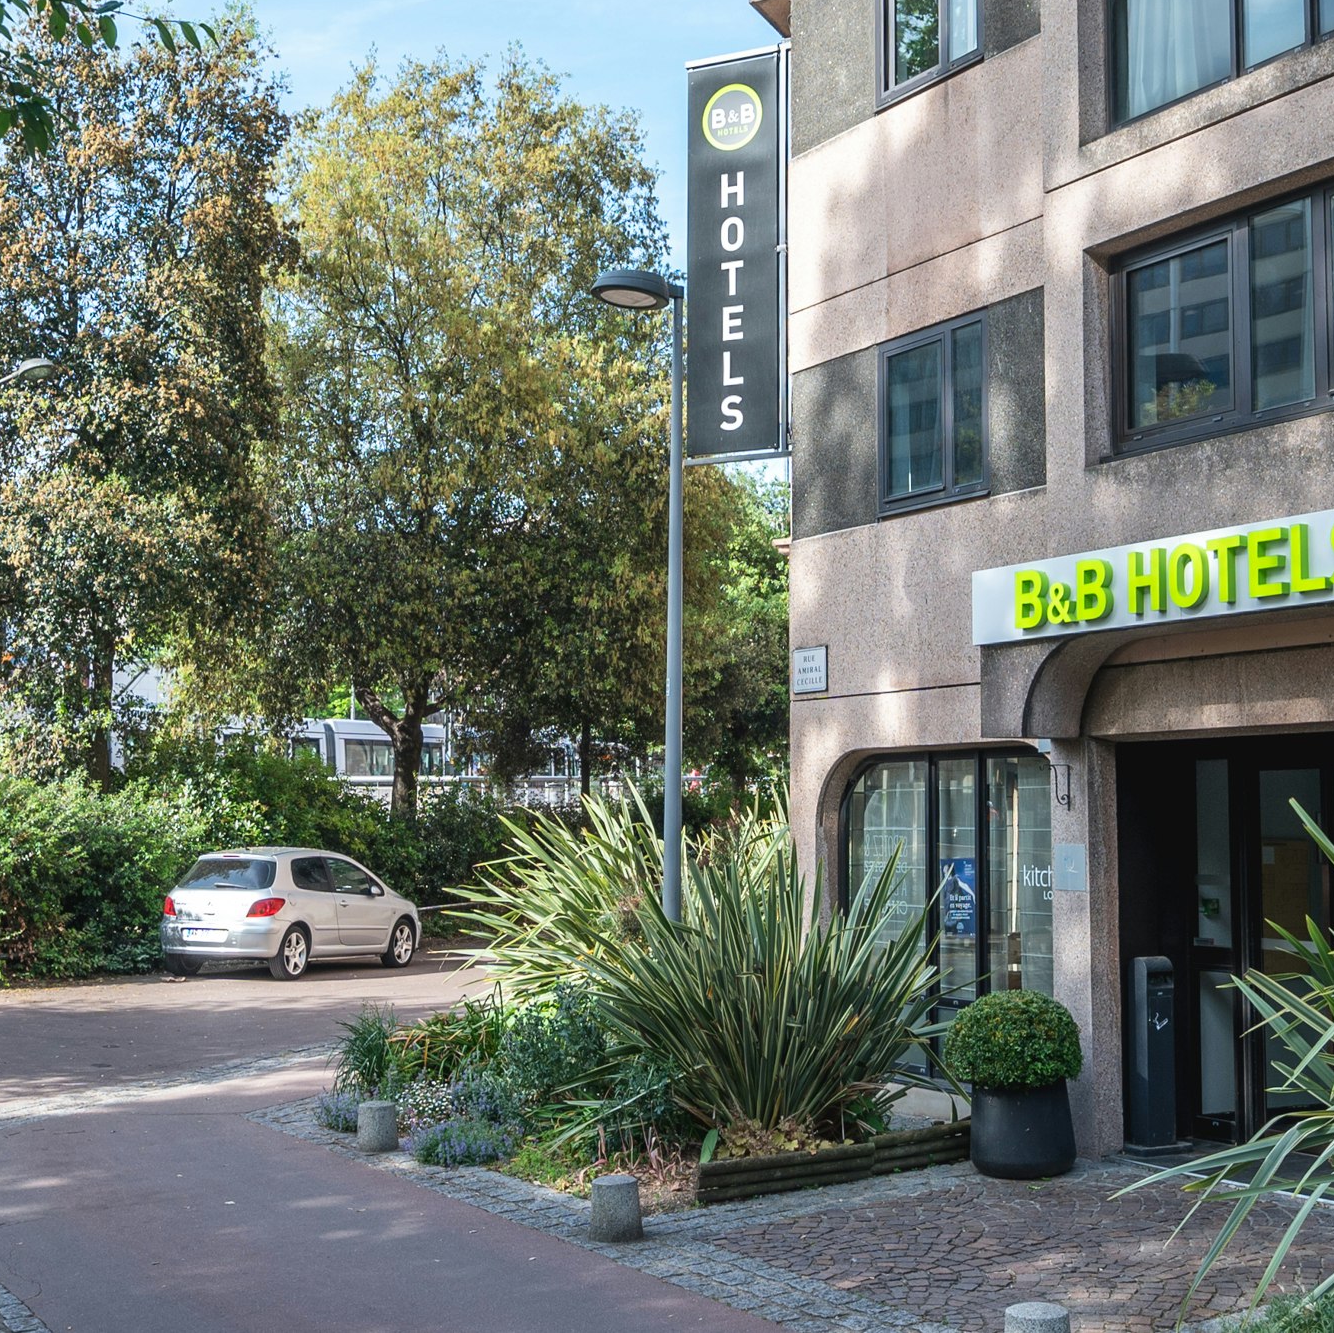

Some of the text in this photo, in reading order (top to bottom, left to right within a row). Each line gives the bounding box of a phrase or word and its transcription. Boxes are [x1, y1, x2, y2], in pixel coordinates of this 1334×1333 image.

[711, 103, 755, 129] B&B
[717, 125, 749, 137] HOTELS
[720, 171, 745, 432] HOTELS
[1014, 559, 1113, 630] B&B
[803, 655, 815, 663] RUE
[798, 666, 822, 674] AMIRAL
